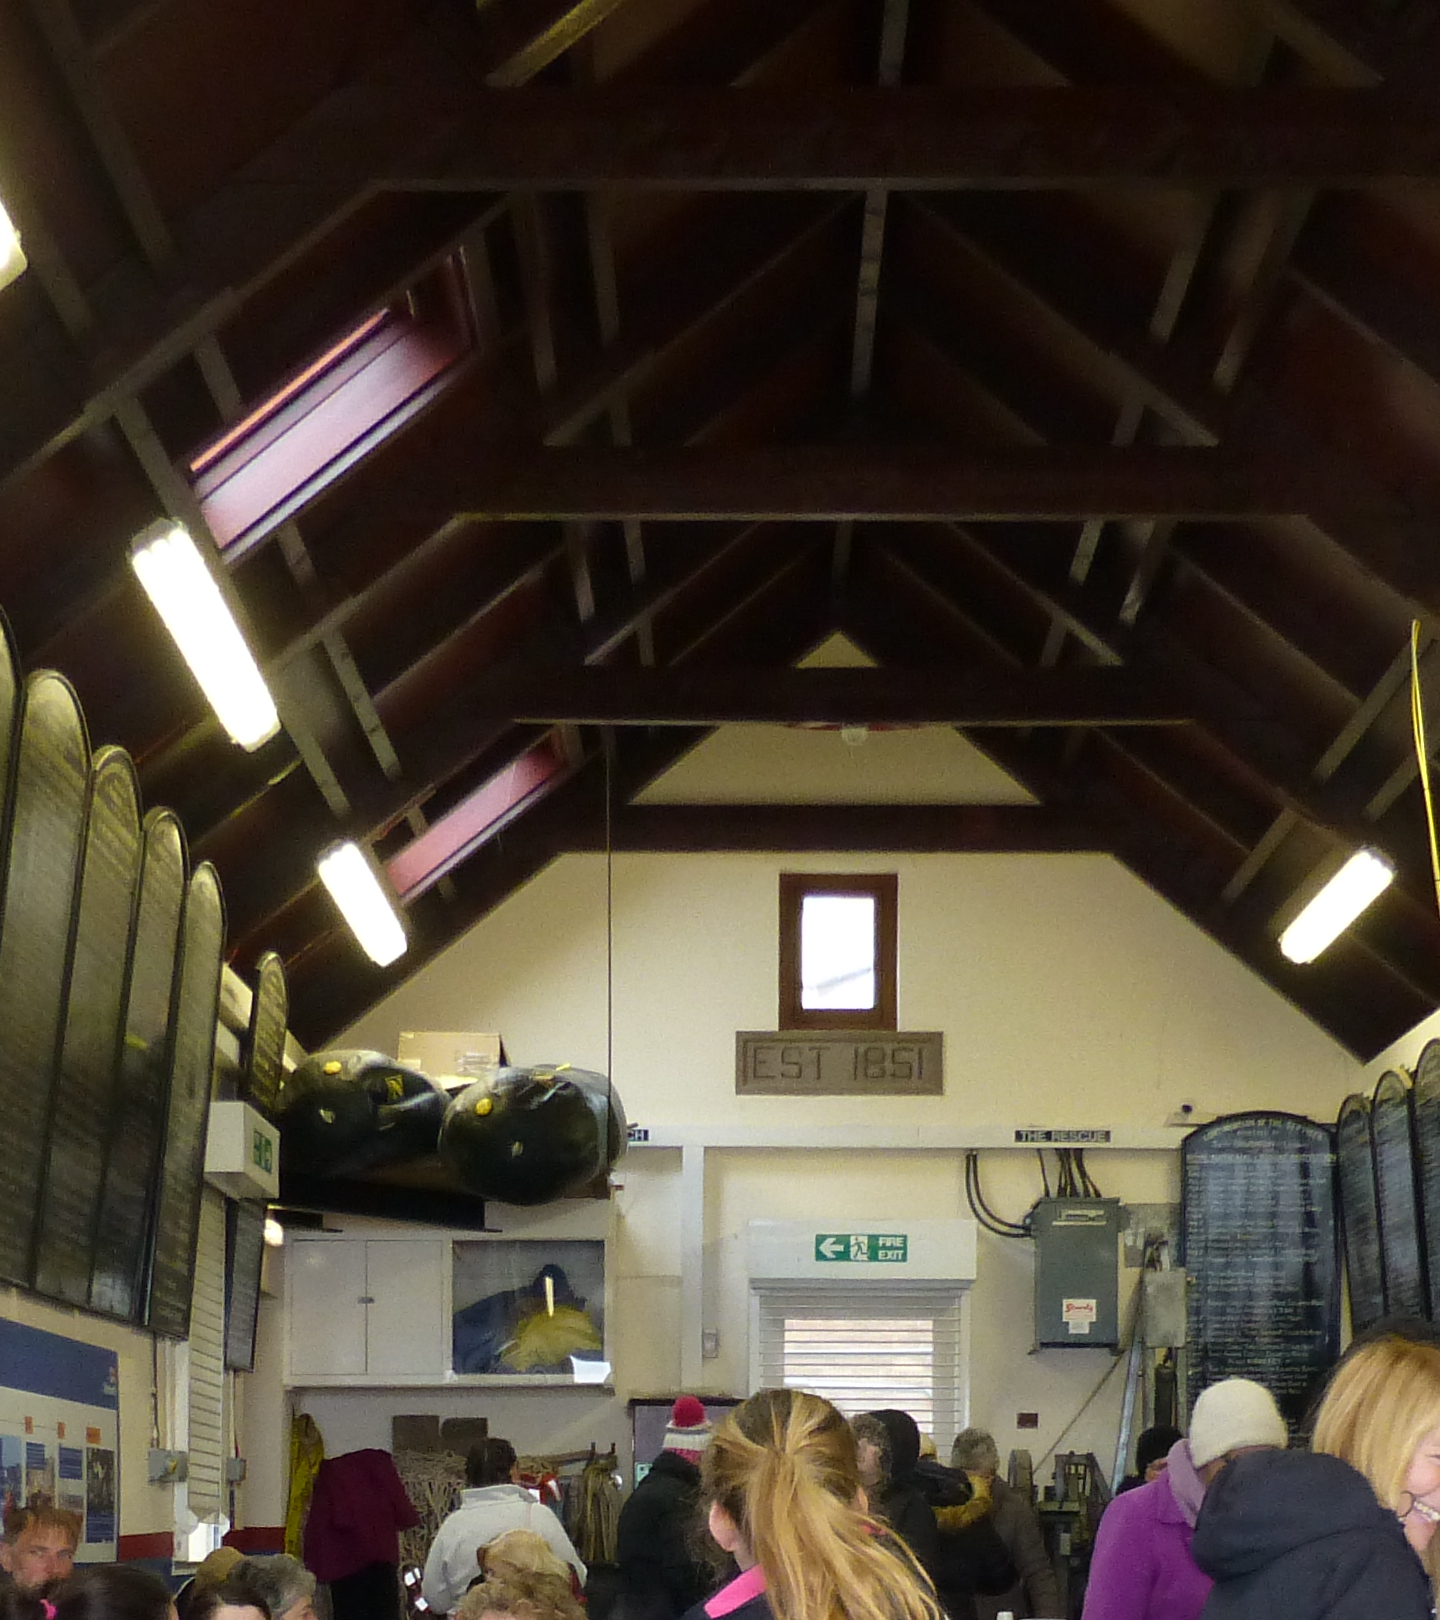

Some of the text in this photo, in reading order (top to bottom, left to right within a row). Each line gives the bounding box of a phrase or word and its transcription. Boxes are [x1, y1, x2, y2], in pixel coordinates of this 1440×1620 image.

[751, 1046, 925, 1081] EST 1851
[878, 1236, 905, 1248] FIRE
[878, 1250, 904, 1261] EXIT
